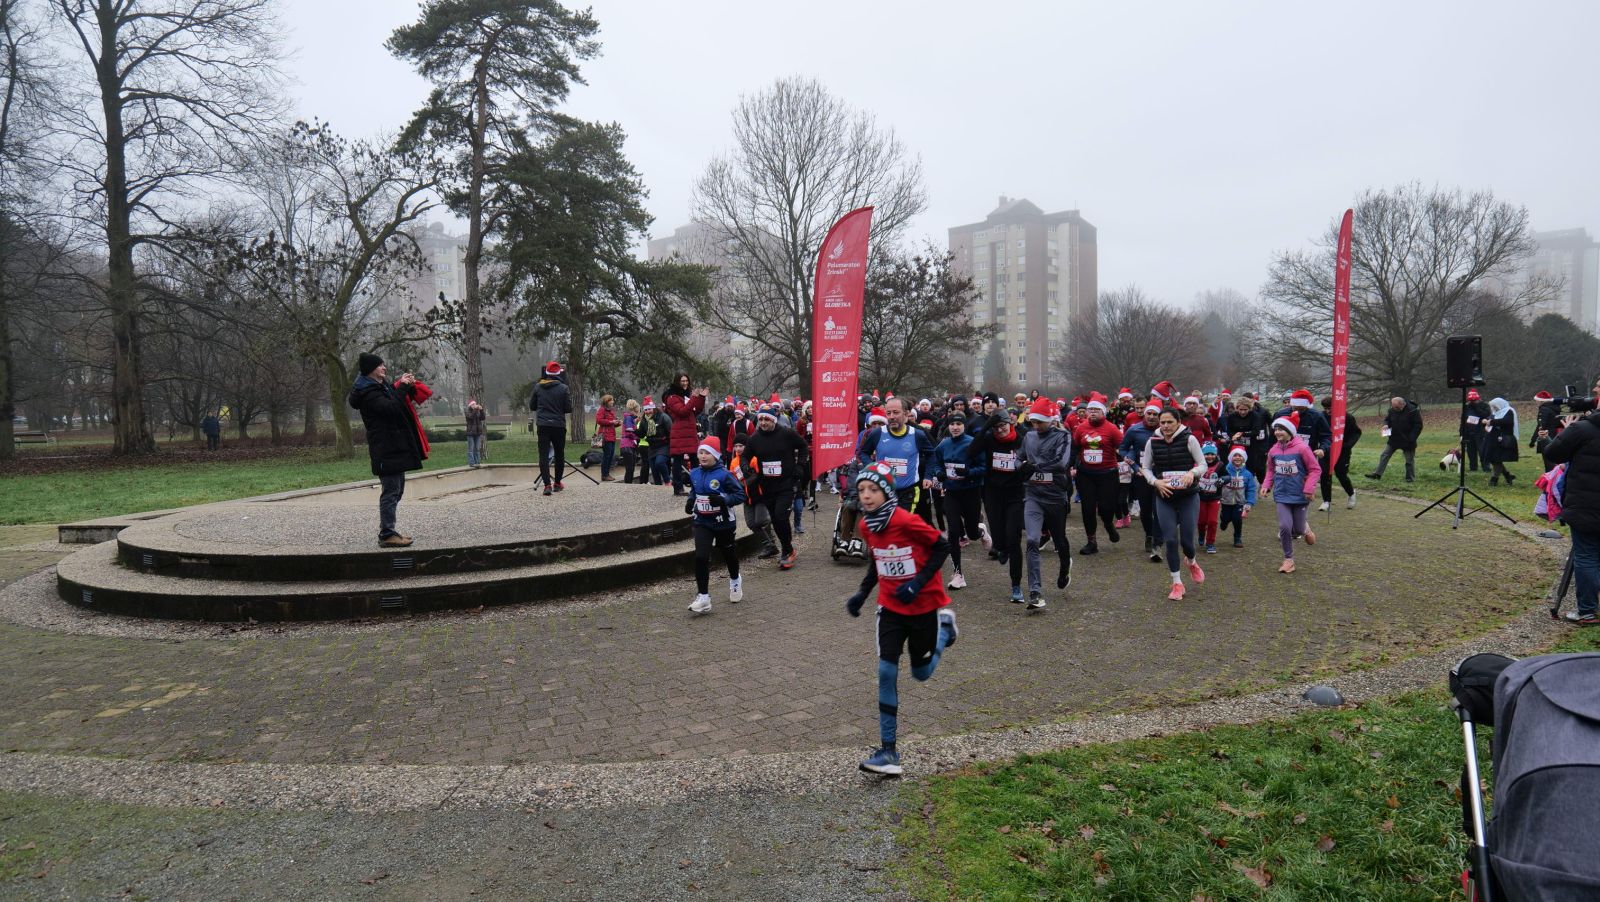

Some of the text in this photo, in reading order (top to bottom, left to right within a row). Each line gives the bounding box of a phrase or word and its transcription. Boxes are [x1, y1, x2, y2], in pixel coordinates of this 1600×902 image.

[1000, 461, 1009, 469] 51
[1280, 466, 1293, 474] 190
[884, 562, 906, 576] 188
